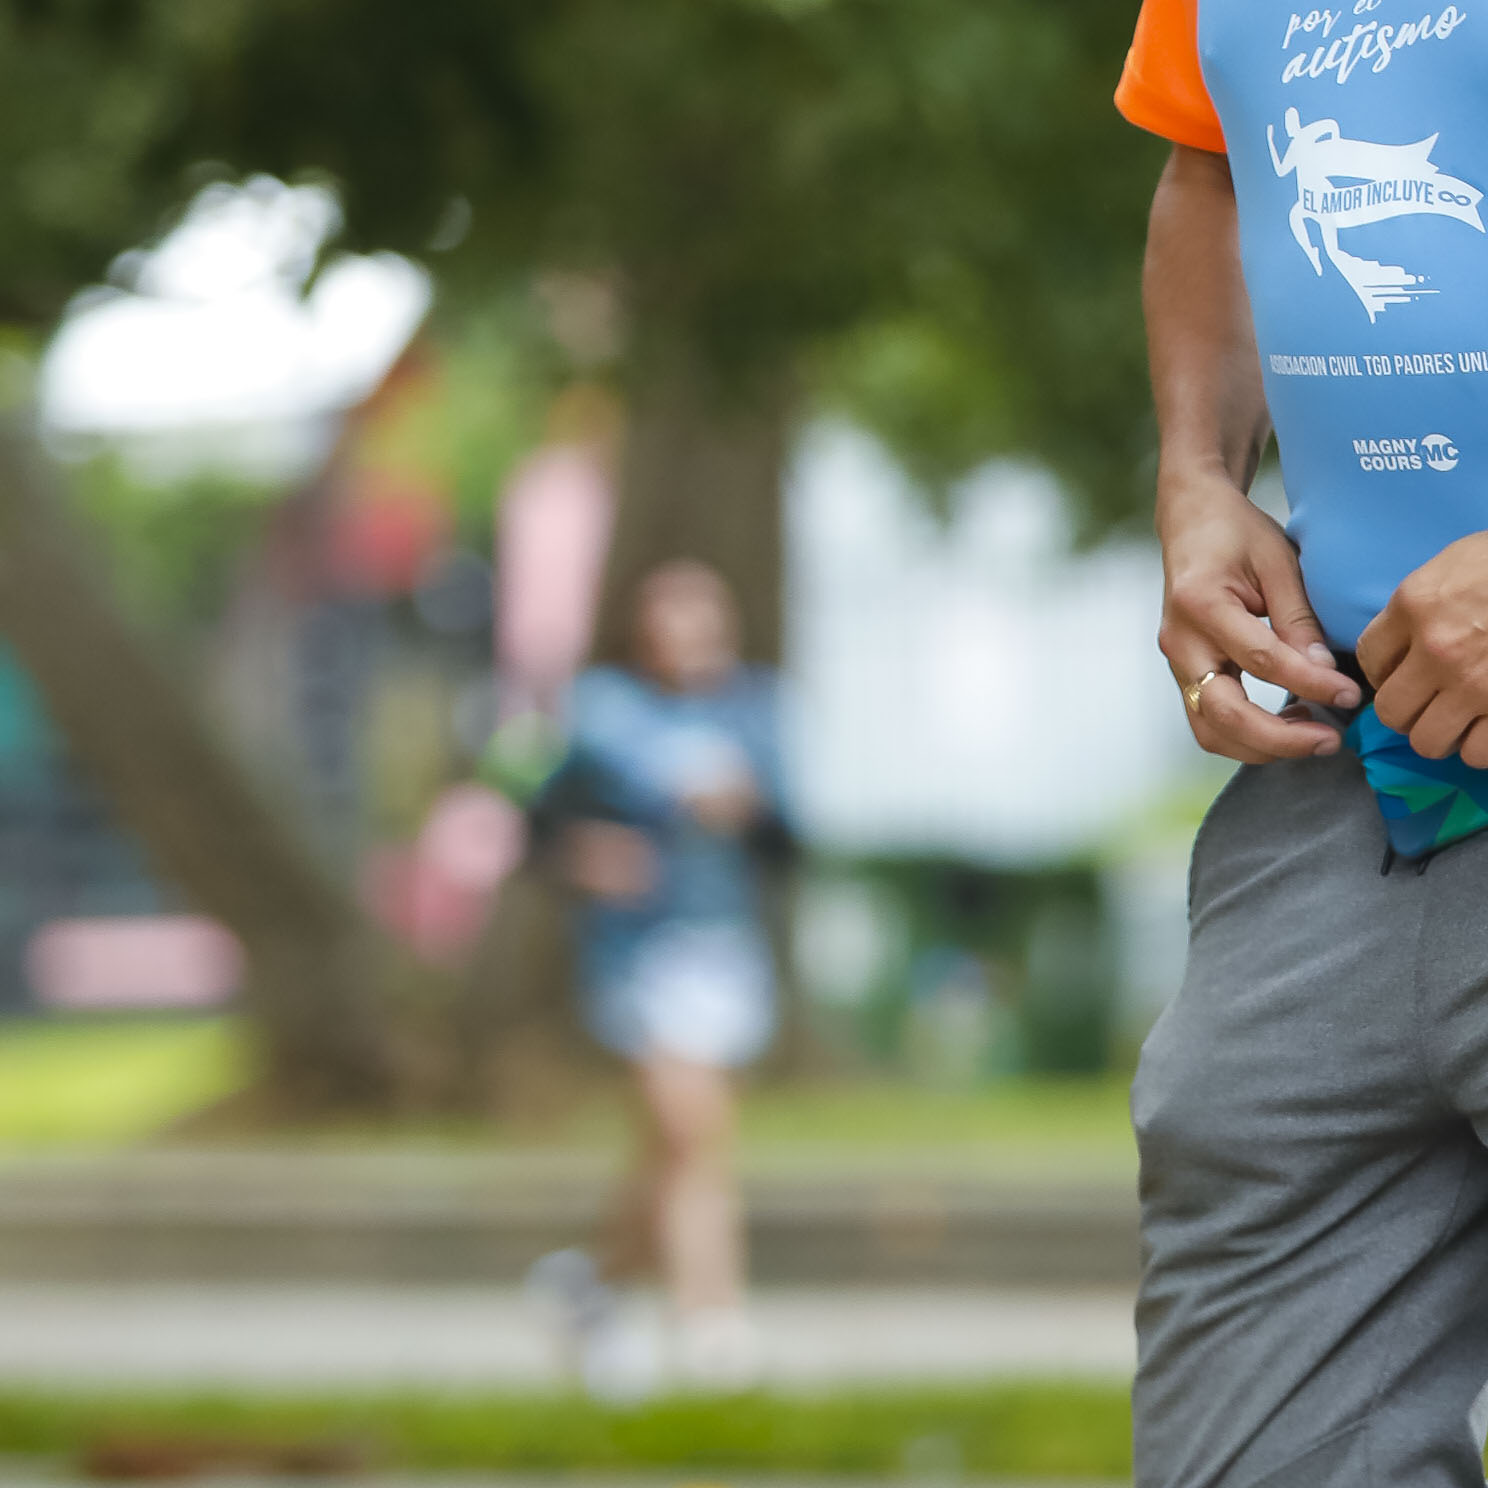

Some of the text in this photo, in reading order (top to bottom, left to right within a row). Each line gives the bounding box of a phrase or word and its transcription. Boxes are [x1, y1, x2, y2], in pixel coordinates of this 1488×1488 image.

[1280, 8, 1341, 49] por
[1281, 5, 1467, 85] autismo
[1303, 180, 1435, 214] EL AMOR INCLUYE
[1328, 355, 1363, 377] CIVIL
[1363, 354, 1392, 376] TGD
[1394, 352, 1456, 375] PADRES
[1352, 438, 1418, 455] MAGNY
[1359, 455, 1423, 472] COURS
